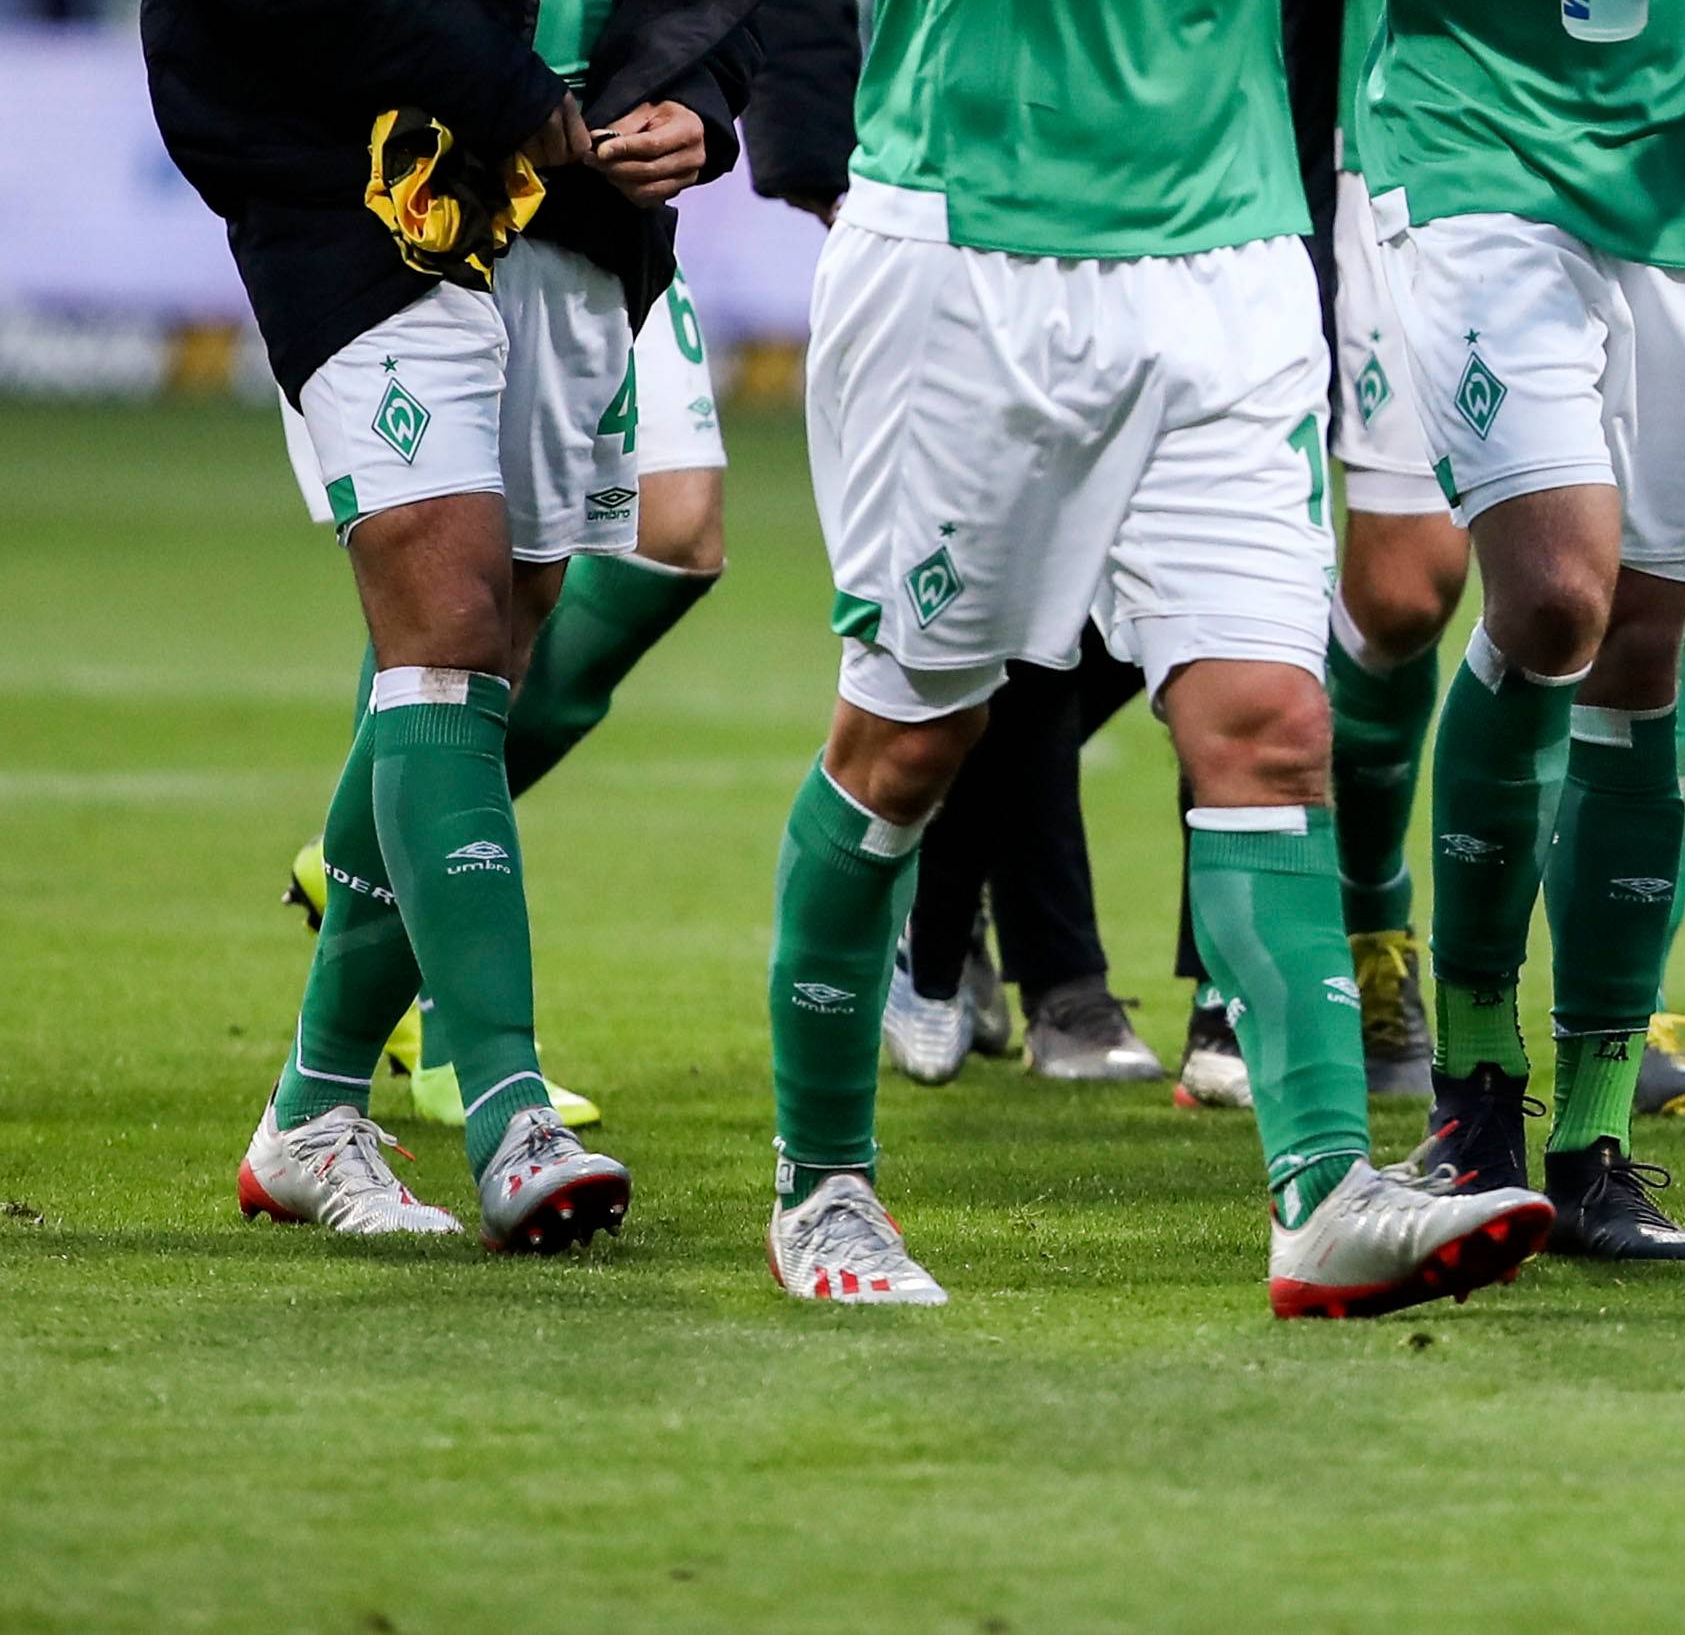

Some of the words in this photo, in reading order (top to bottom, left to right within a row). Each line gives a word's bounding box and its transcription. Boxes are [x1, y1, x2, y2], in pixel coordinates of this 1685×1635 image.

[597, 346, 639, 455] 4
[587, 508, 631, 521] umbro
[446, 860, 512, 875] umbro
